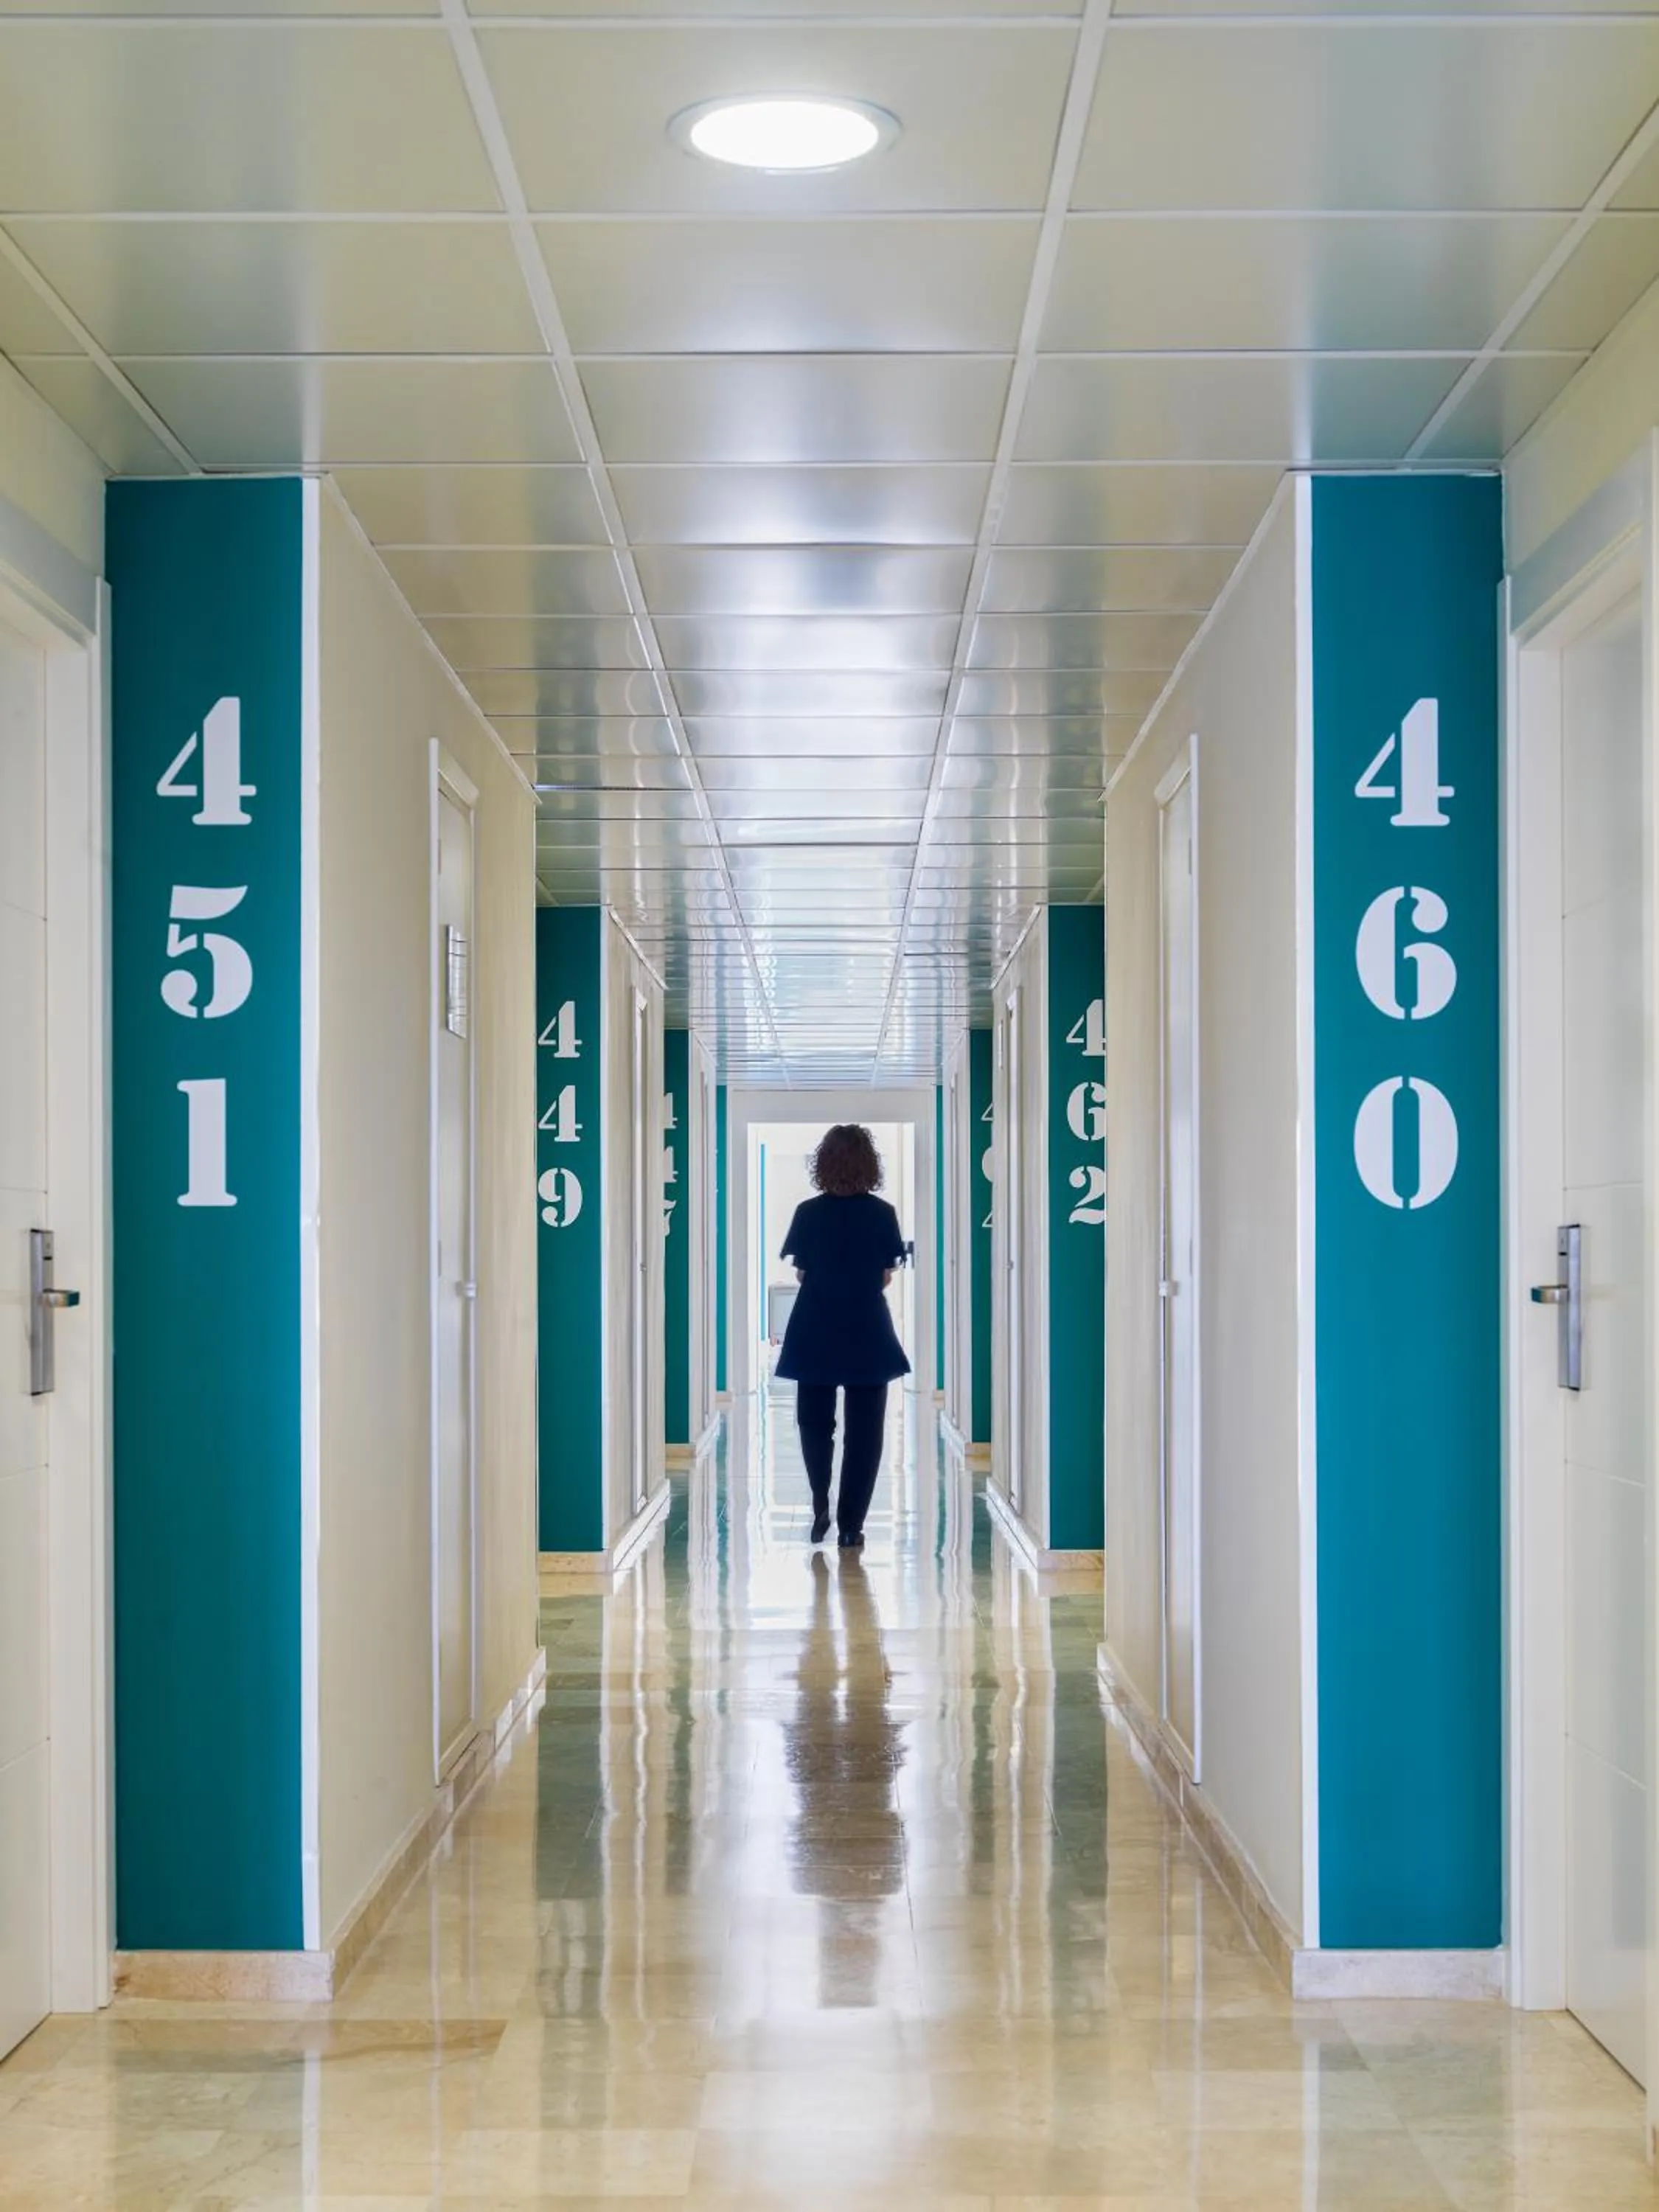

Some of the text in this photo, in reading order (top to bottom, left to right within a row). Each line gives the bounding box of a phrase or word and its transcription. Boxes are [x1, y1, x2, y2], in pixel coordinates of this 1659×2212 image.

[157, 697, 257, 1206] 451
[538, 1001, 582, 1228] 449
[1066, 999, 1105, 1225] 462
[1354, 698, 1458, 1209] 460
